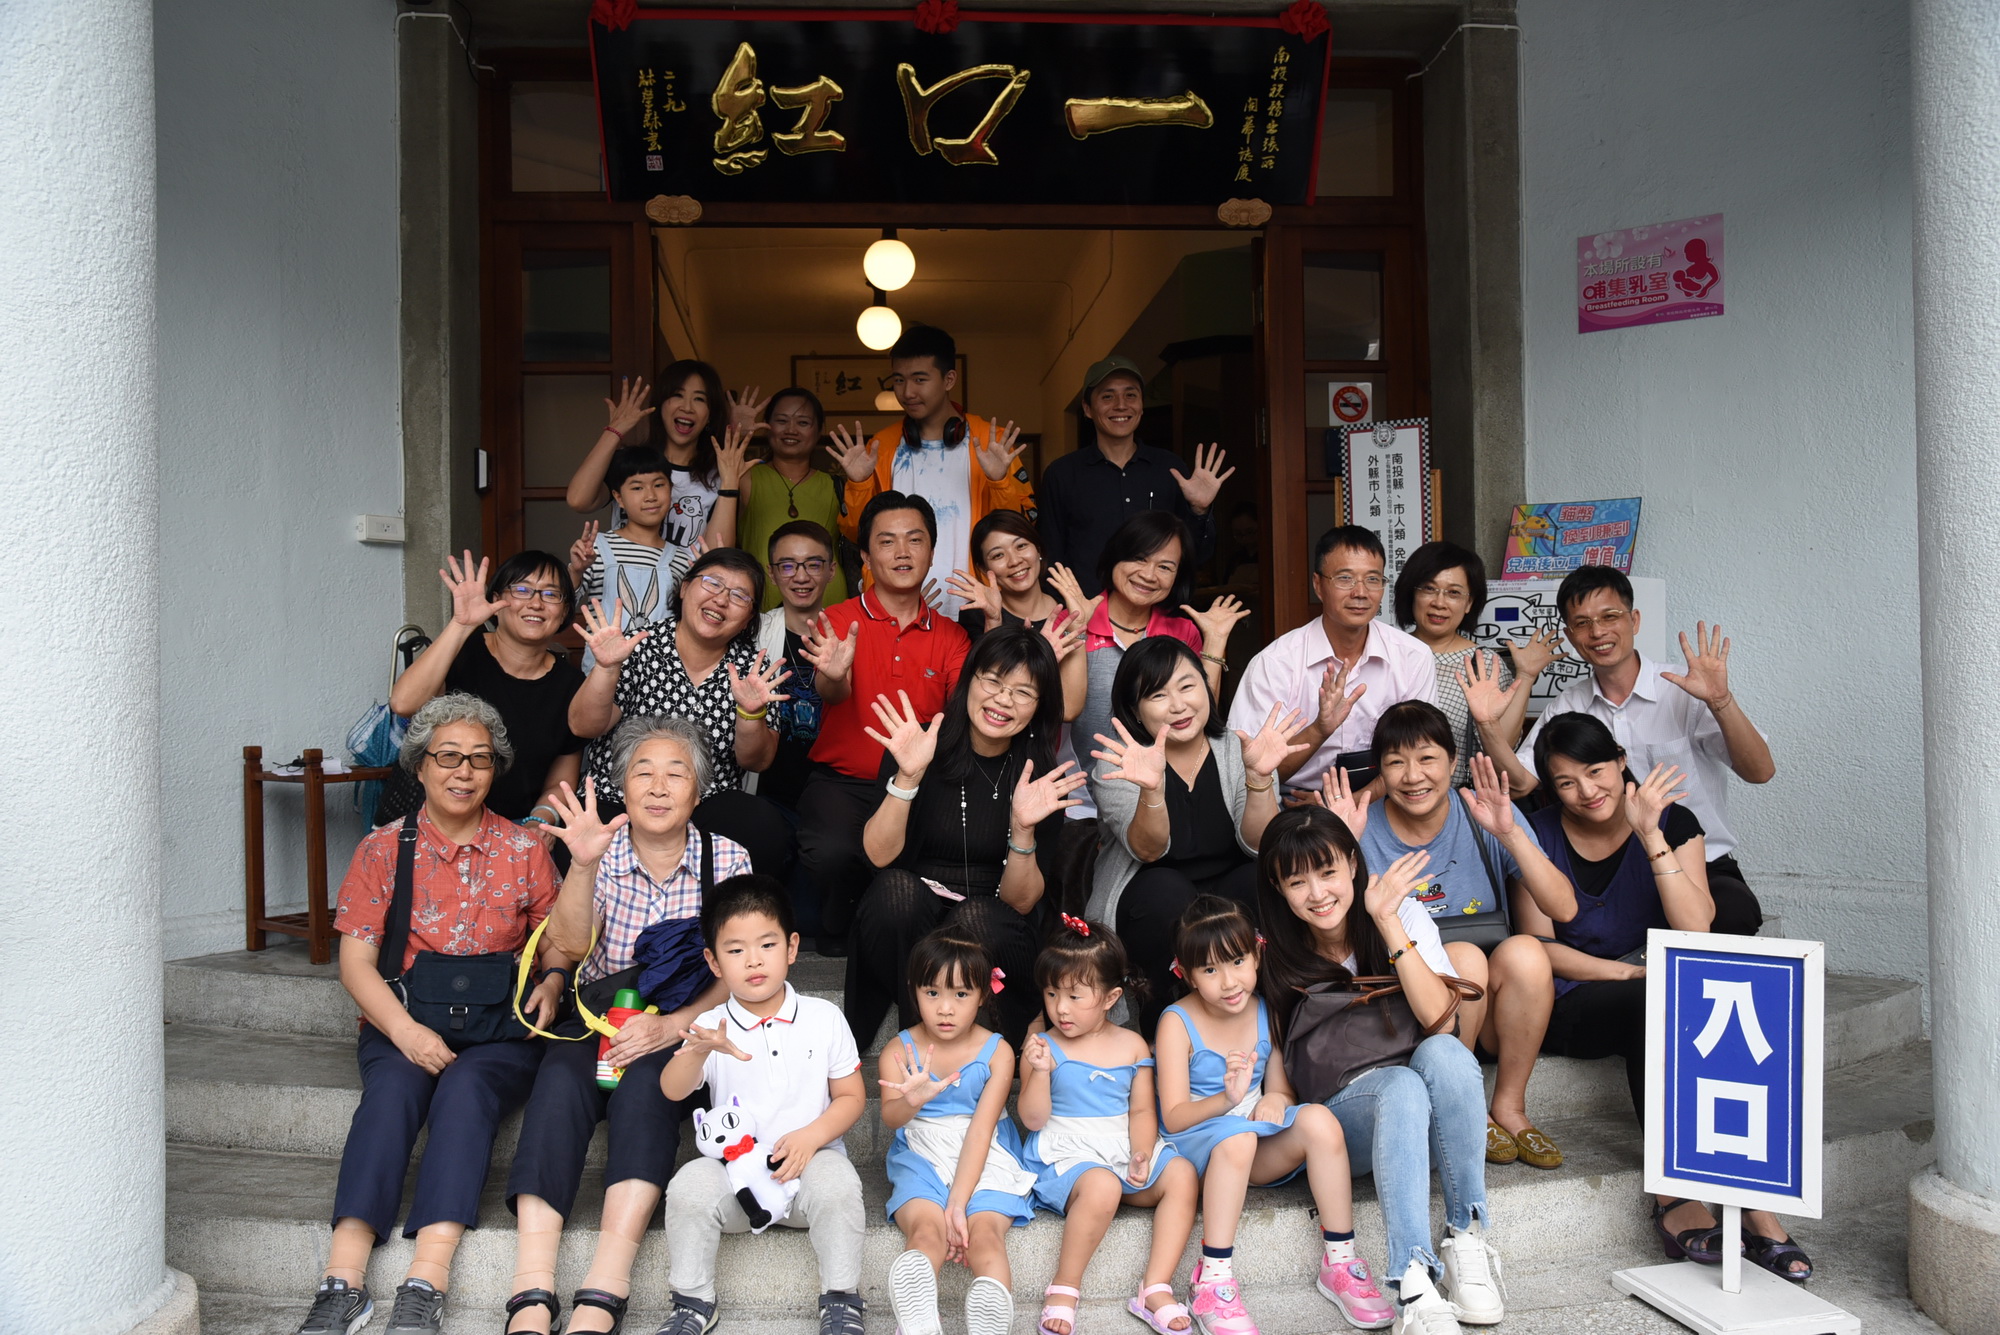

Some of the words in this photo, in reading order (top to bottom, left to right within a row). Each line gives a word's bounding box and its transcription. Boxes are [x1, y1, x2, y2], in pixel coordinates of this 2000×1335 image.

[1583, 254, 1663, 277] 本場所設有
[1583, 272, 1669, 301] 哺集乳室
[1587, 297, 1640, 312] Breastfeeding
[1642, 294, 1665, 304] Room
[1368, 454, 1381, 517] 外縣市人類
[1559, 505, 1595, 522] 貓幣
[1692, 978, 1774, 1163] 入口
